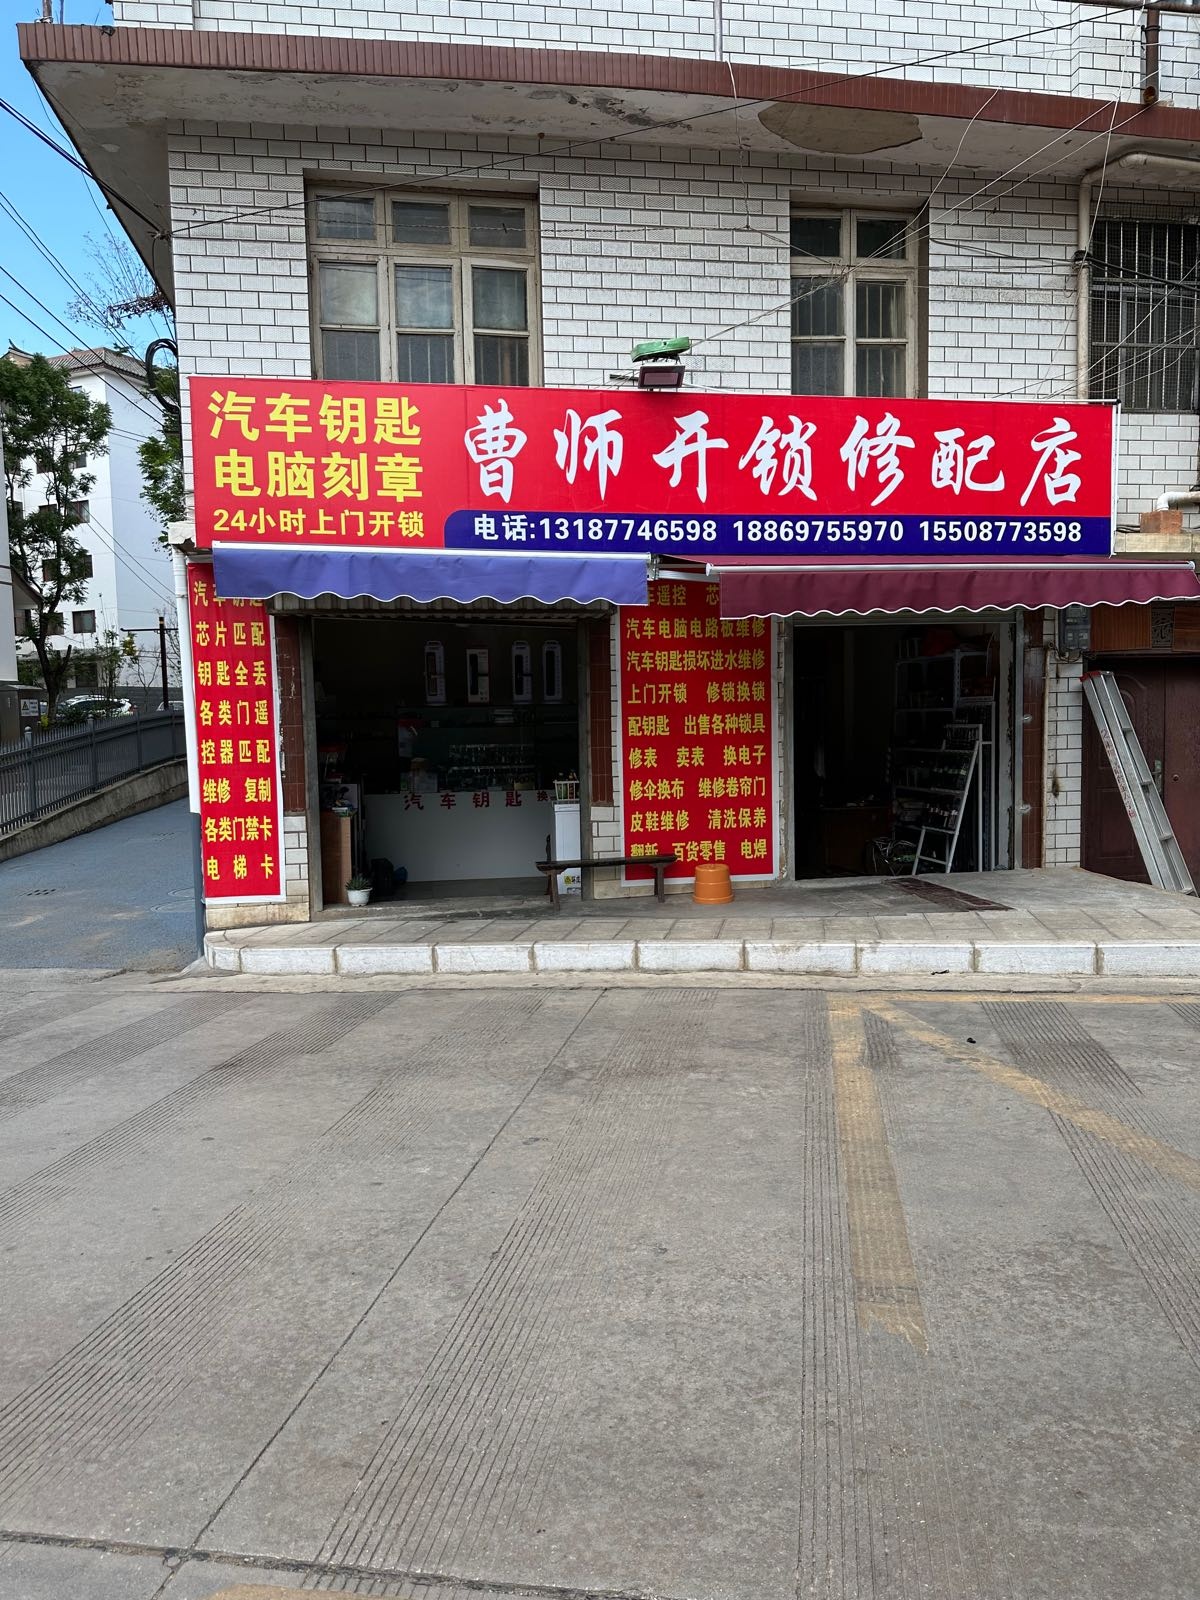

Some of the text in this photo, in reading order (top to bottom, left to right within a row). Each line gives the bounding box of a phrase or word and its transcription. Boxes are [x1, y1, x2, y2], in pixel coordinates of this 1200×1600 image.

[208, 390, 421, 445] 汽车钥匙
[464, 398, 1082, 507] 曹师开锁修配店
[214, 448, 423, 503] 电脑刻章
[214, 507, 424, 537] 24小时上门开锁
[733, 521, 903, 541] 18869755970
[919, 522, 1081, 541] 15508773598
[706, 584, 719, 604] 芯
[196, 622, 265, 646] 芯片匹配
[626, 617, 766, 640] 汽车电脑电路板维修
[198, 661, 266, 686] 钥匙全丢
[626, 649, 766, 673] 汽车钥匙损坏进水维修
[628, 681, 765, 704] 上门开锁 修锁换锁
[200, 700, 268, 725] 各类门遥
[627, 712, 765, 737] 配钥匙 出售各种锁具
[201, 740, 270, 764] 控器匹配
[628, 744, 766, 769] 修表 卖表 换电子
[203, 778, 271, 803] 维修 复制
[404, 790, 556, 810] 汽车钥匙 换
[629, 776, 766, 801] 修伞换布 维修卷帘门
[205, 817, 272, 842] 各类门禁卡
[630, 807, 767, 833] 皮鞋维修 清洗保养
[672, 839, 726, 862] 百货零售
[740, 838, 767, 859] 电焊
[207, 855, 272, 880] 电梯卡
